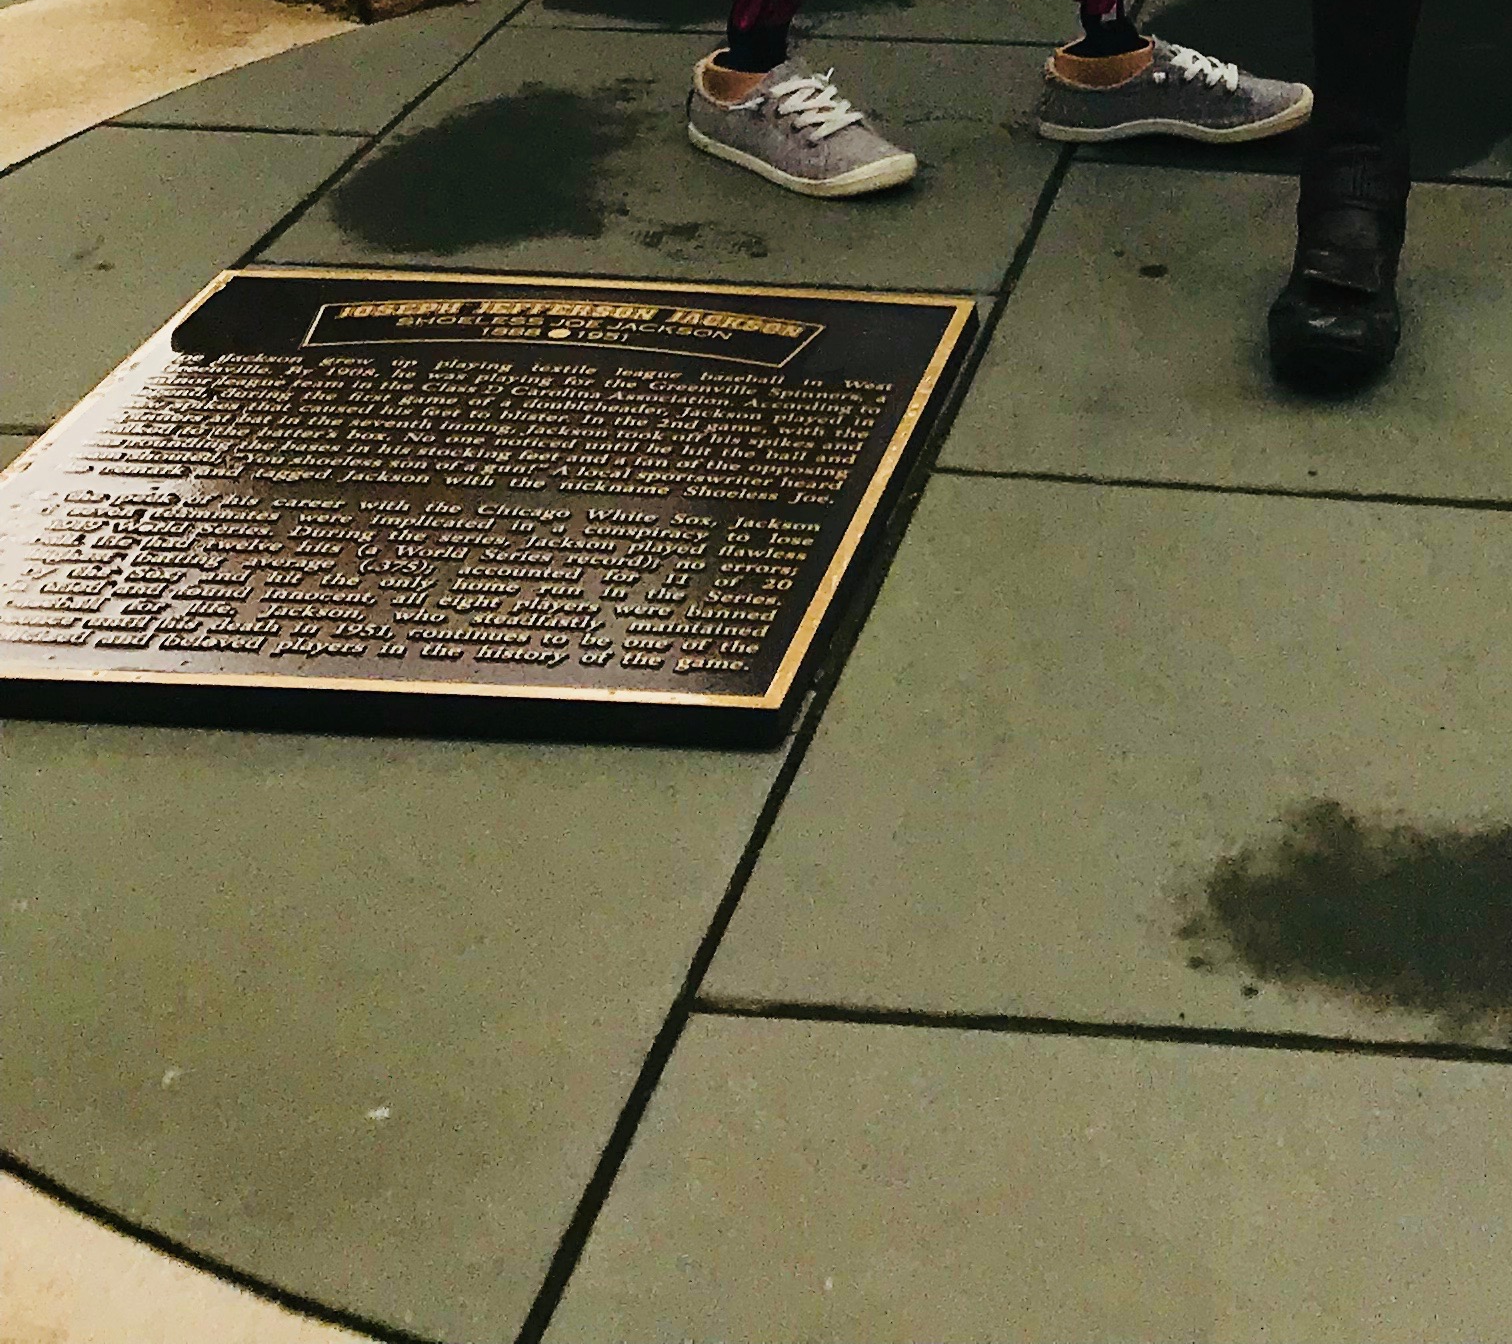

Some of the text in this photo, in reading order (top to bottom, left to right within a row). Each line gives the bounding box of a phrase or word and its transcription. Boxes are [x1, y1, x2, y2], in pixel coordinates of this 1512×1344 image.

[339, 300, 804, 339] JOSEPH JEFFERSON JACKSON
[396, 315, 734, 341] SHOELESS JOE JACKSON
